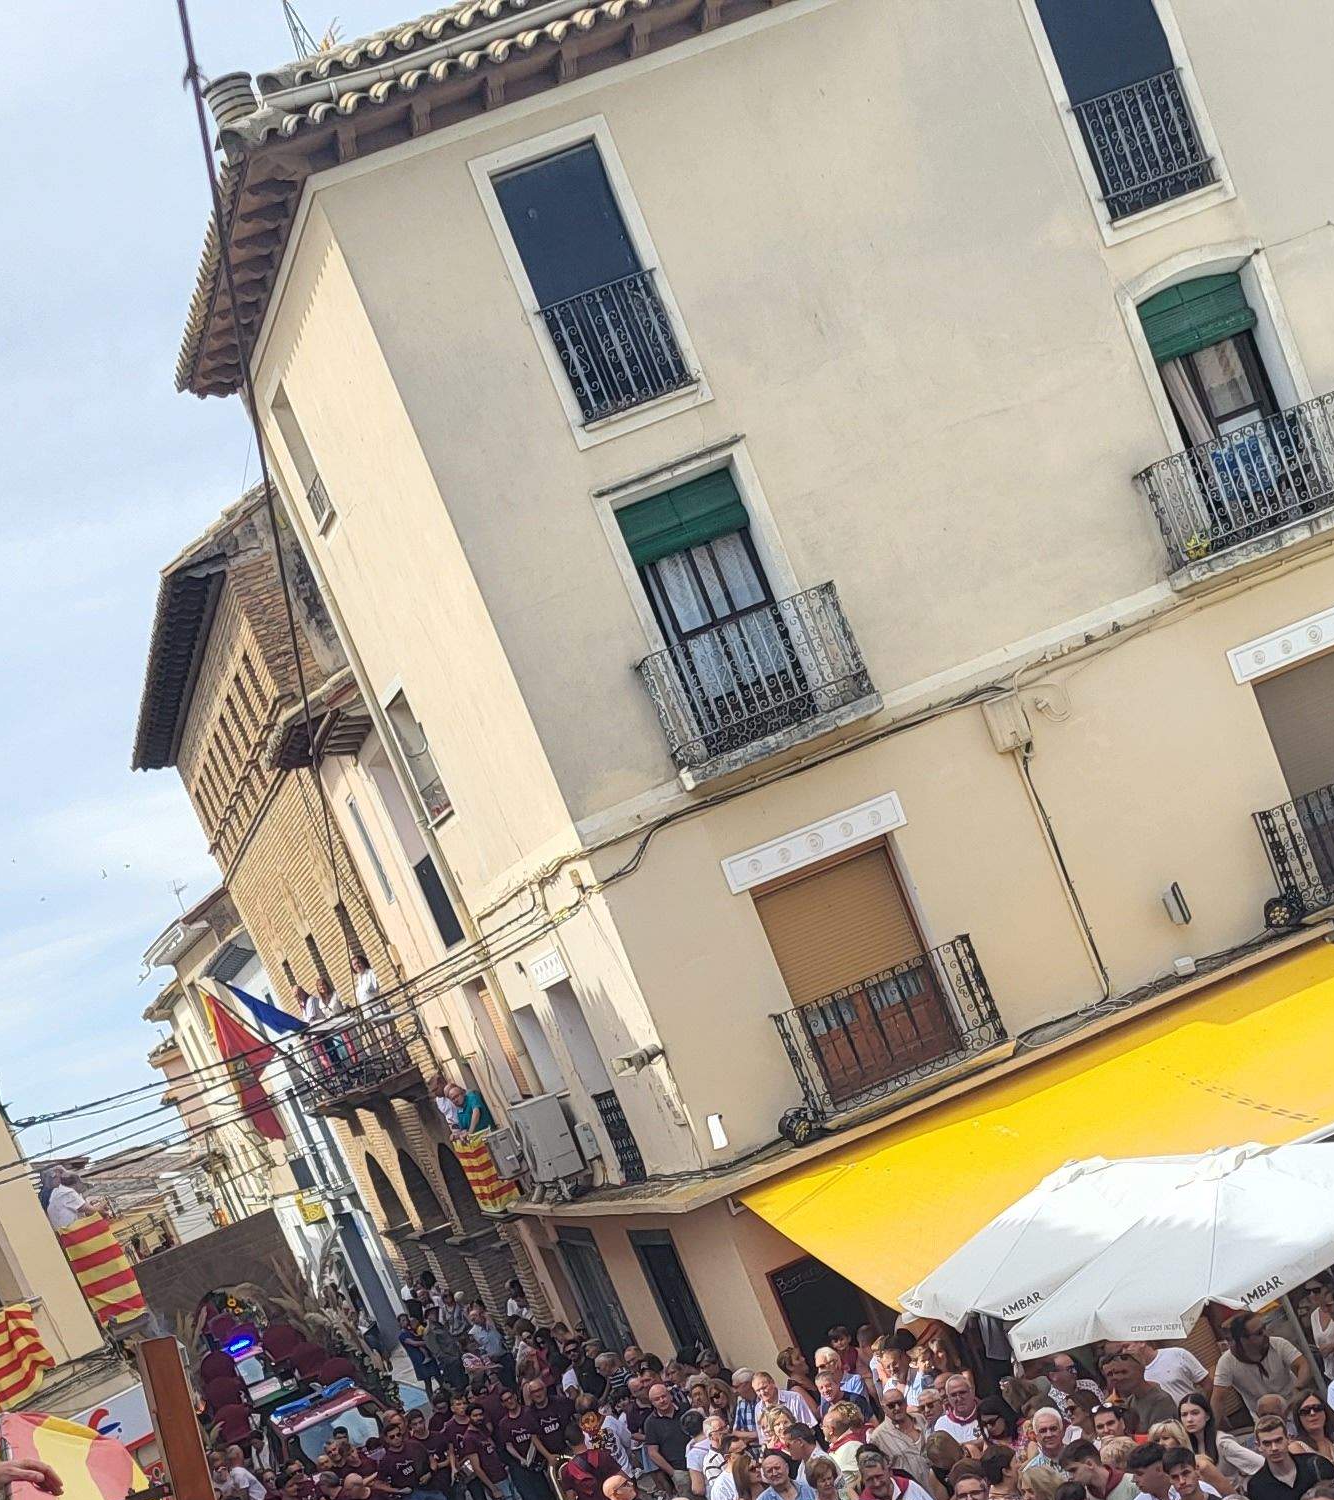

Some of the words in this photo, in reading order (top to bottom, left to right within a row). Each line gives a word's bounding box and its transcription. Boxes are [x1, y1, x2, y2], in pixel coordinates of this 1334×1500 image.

[1001, 1291, 1043, 1318] AMBAR
[1239, 1275, 1285, 1307] AMBAR
[1026, 1336, 1049, 1351] AMBAR
